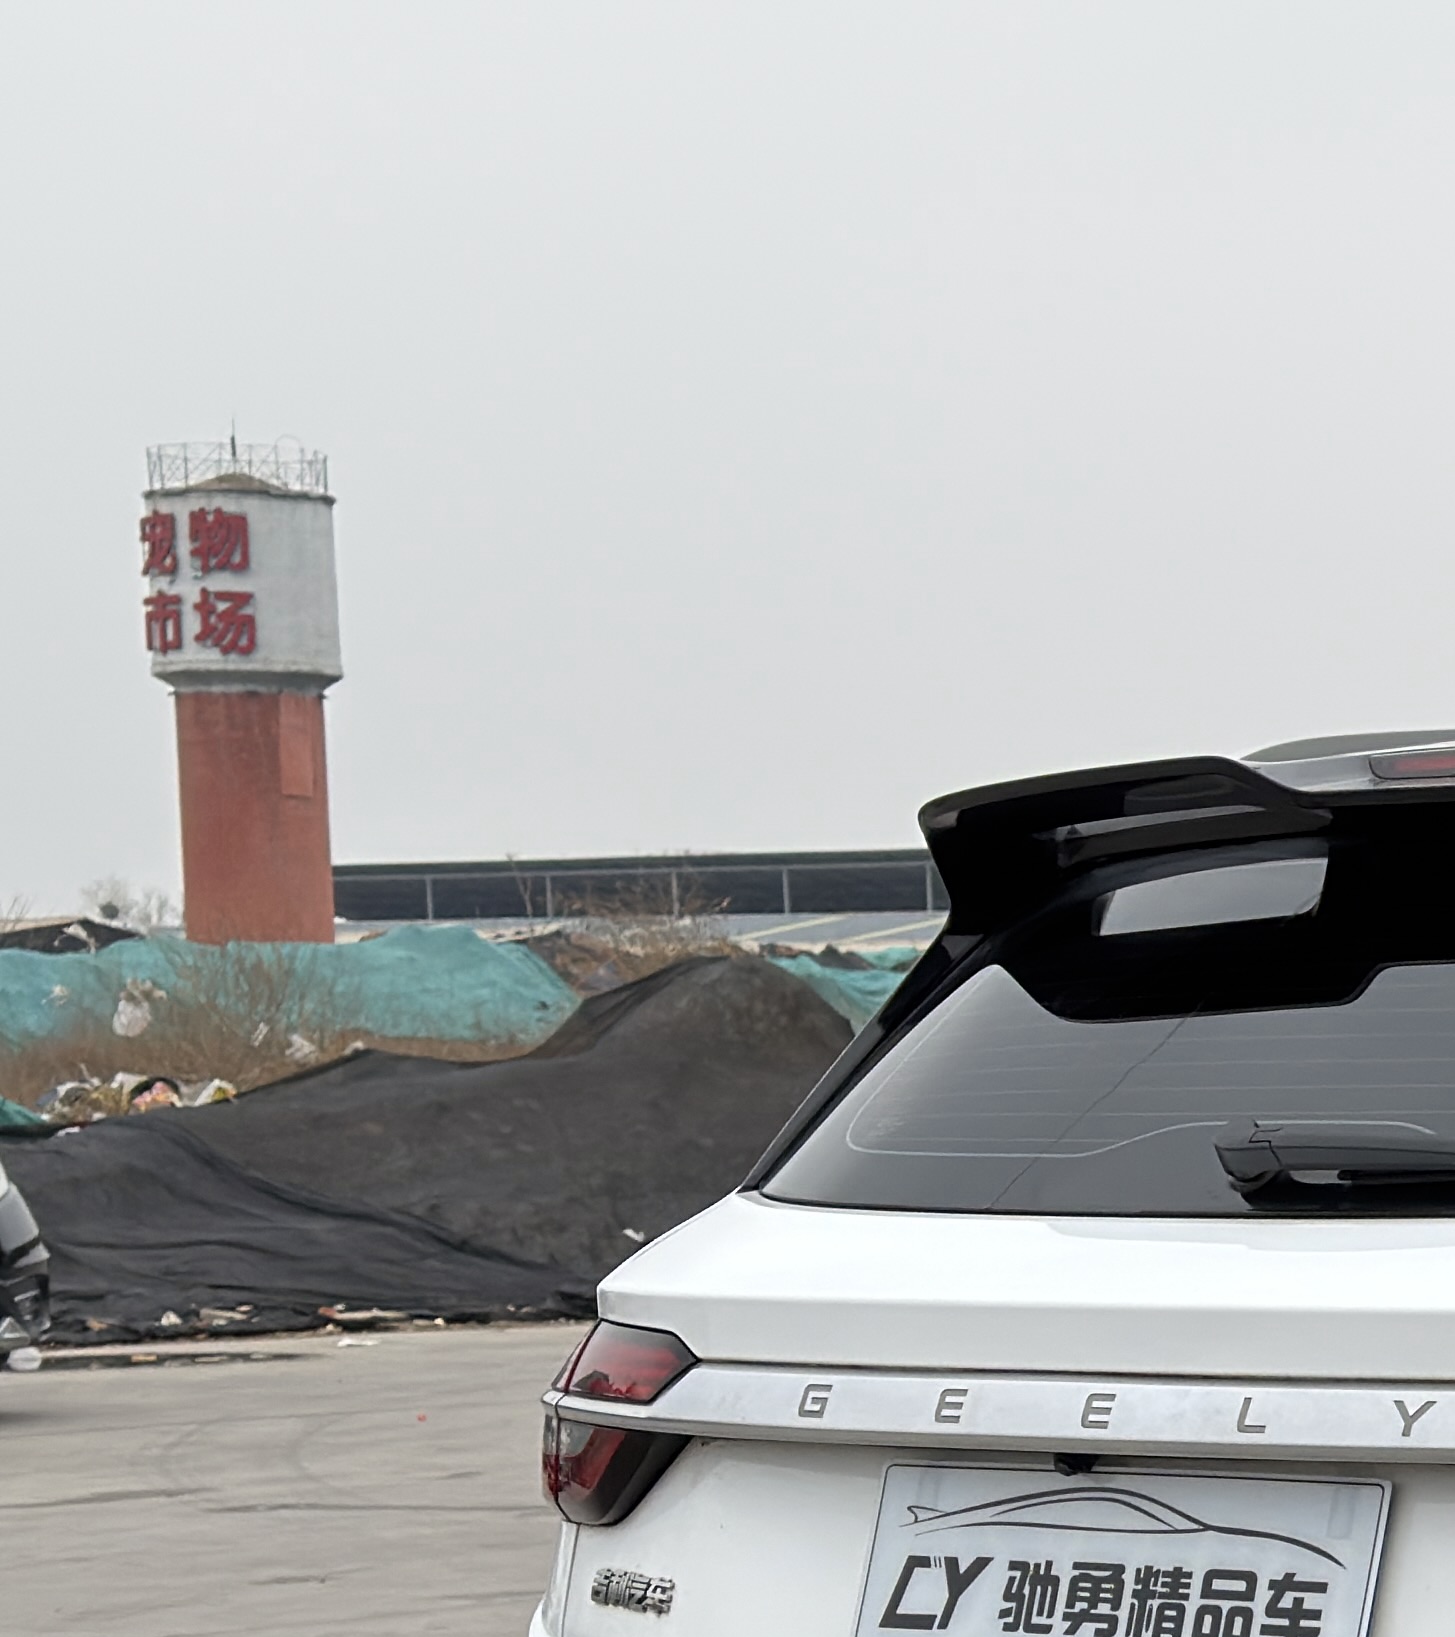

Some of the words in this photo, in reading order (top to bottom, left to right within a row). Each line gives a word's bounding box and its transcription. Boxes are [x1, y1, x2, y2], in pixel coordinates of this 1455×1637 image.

[143, 587, 257, 657] 市场
[797, 1383, 1437, 1437] GEELY
[878, 1556, 994, 1631] CY
